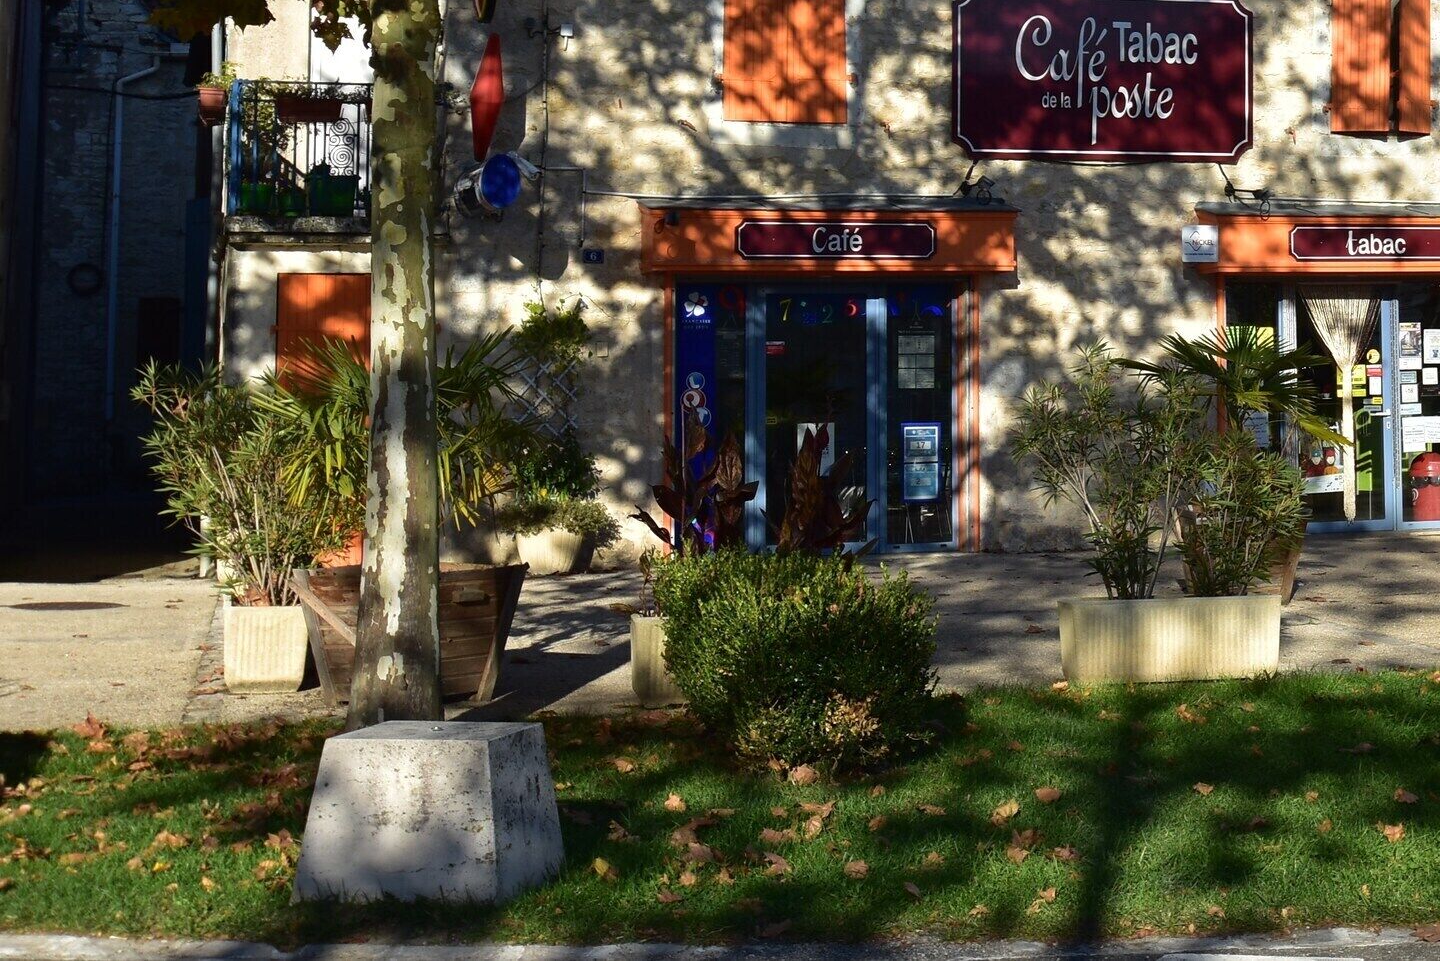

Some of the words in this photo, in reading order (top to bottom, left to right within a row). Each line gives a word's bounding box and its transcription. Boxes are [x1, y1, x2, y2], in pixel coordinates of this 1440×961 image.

[1015, 14, 1108, 109] Café
[1112, 21, 1199, 65] Tabac
[1041, 92, 1057, 109] de
[1060, 92, 1072, 109] la
[1089, 72, 1175, 145] poste
[812, 226, 863, 253] Café
[1345, 230, 1407, 256] tabac
[590, 252, 597, 261] 6
